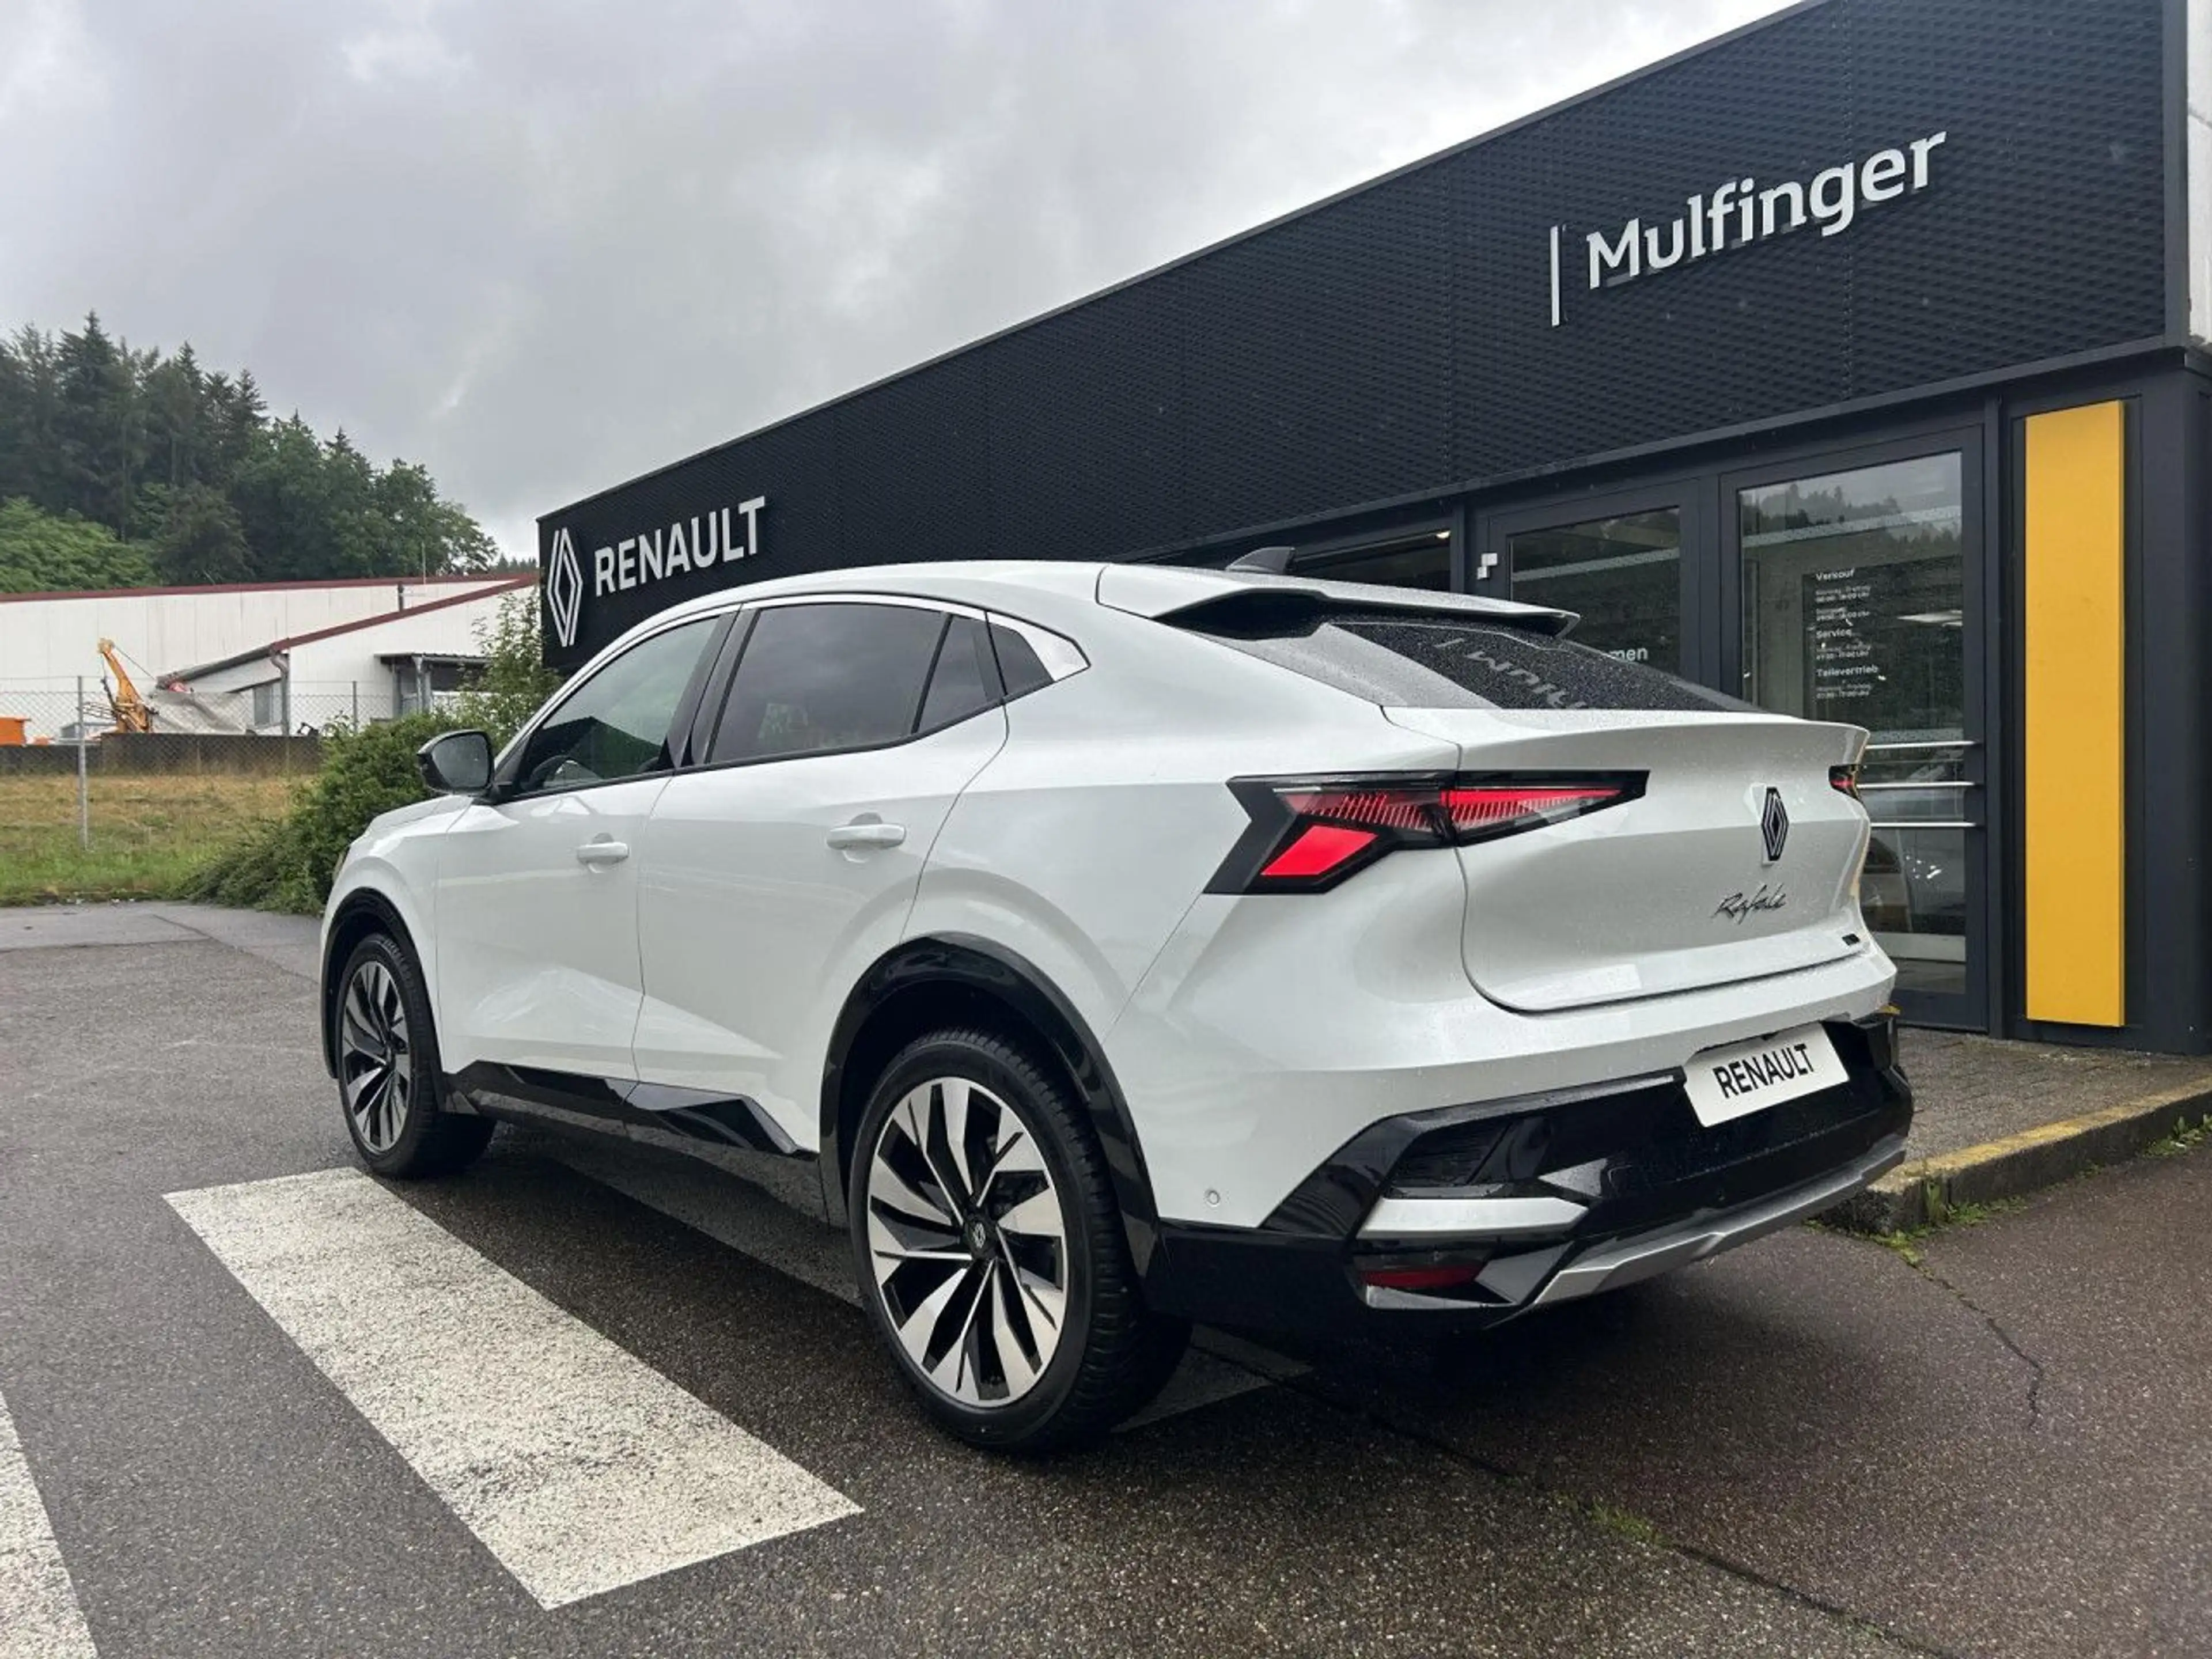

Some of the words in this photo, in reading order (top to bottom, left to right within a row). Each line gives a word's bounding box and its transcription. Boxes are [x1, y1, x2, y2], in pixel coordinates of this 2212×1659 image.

[1586, 131, 1947, 290] Mulfinger
[594, 495, 766, 597] RENAULT
[1713, 1043, 1813, 1098] RENAULT
